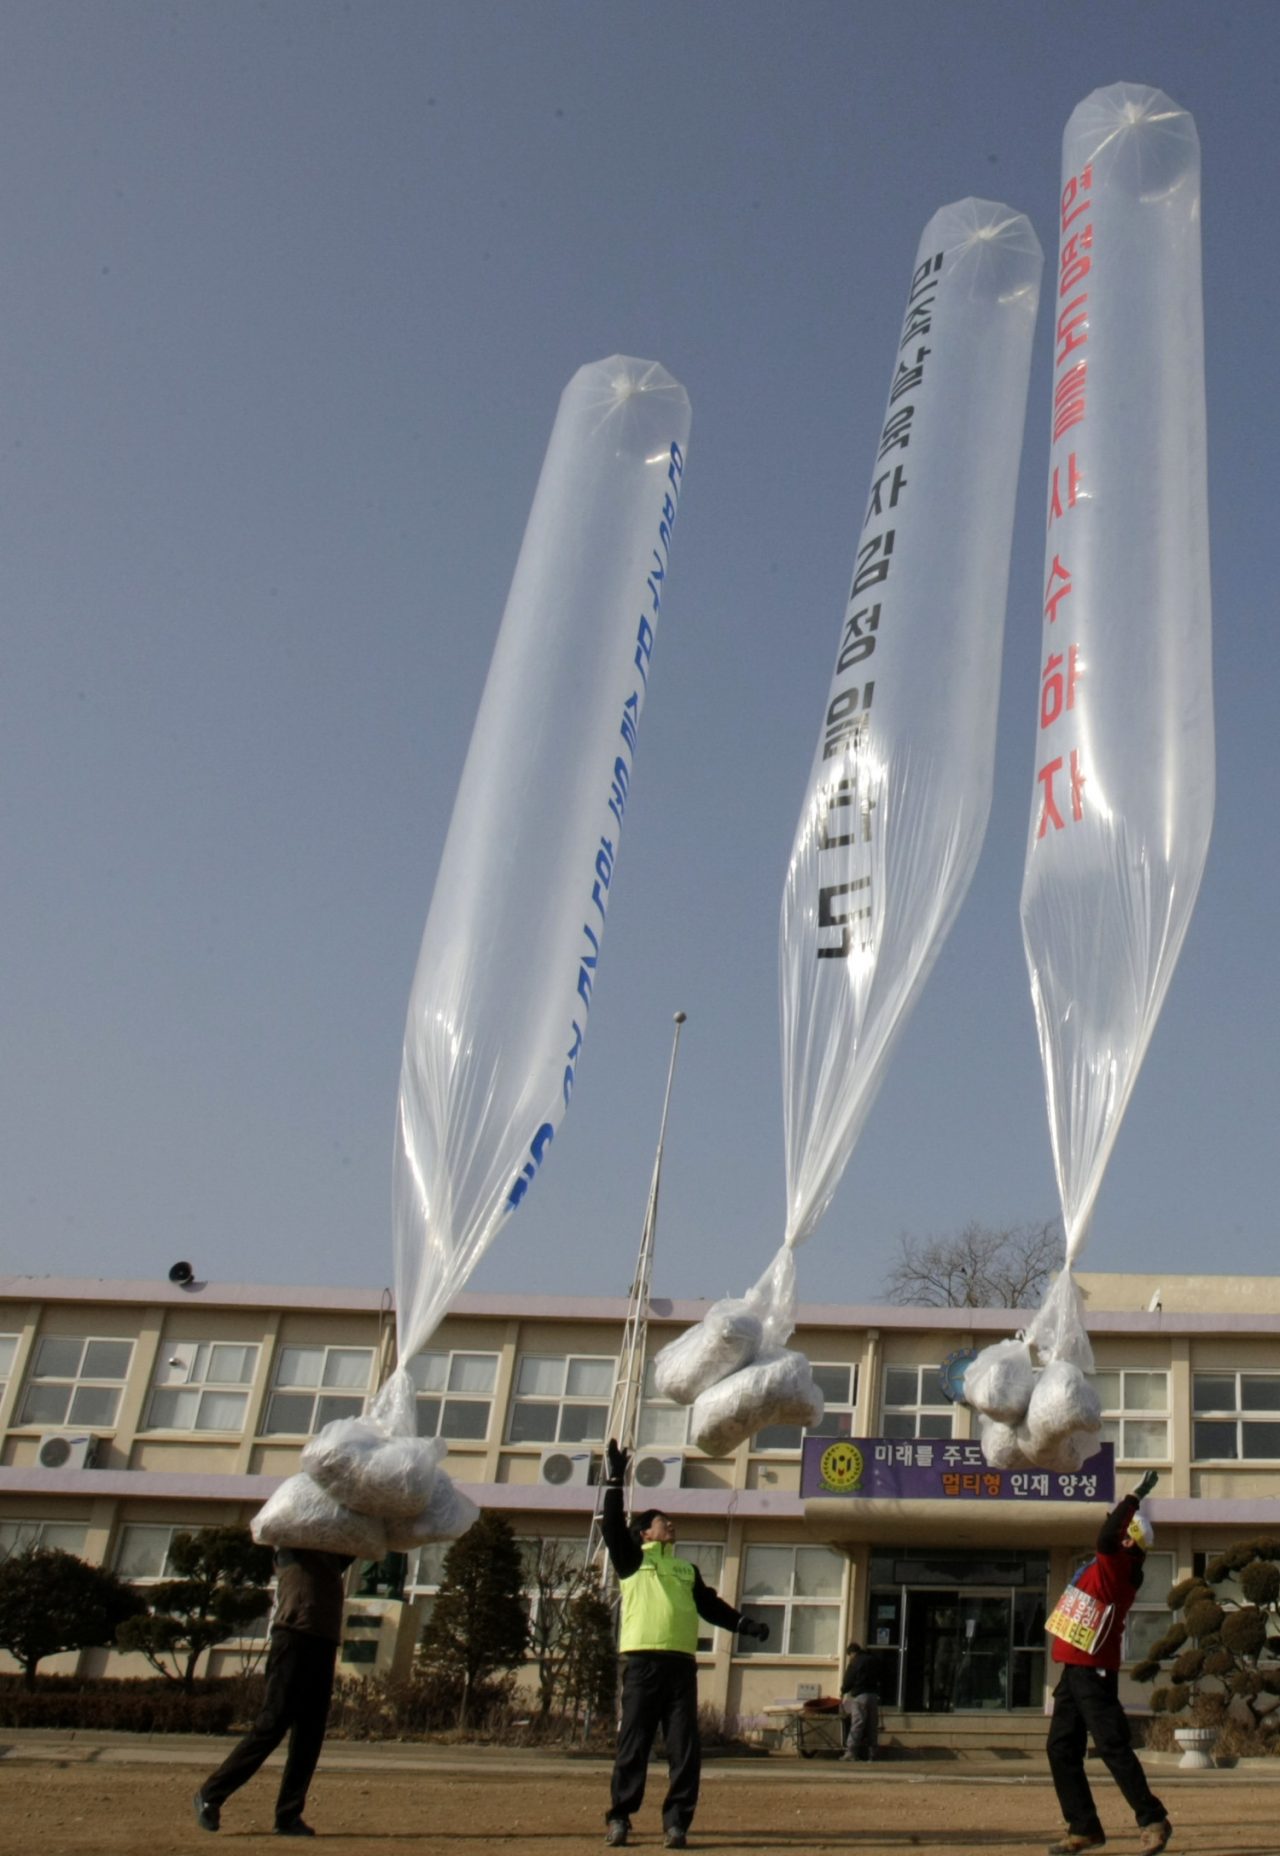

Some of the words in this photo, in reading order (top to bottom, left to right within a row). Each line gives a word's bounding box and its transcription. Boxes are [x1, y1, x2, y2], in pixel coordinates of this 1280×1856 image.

[875, 1445, 934, 1467] 미래를
[942, 1472, 1001, 1496] 멀티형
[1010, 1474, 1049, 1497] 인재
[1058, 1474, 1098, 1497] 양성
